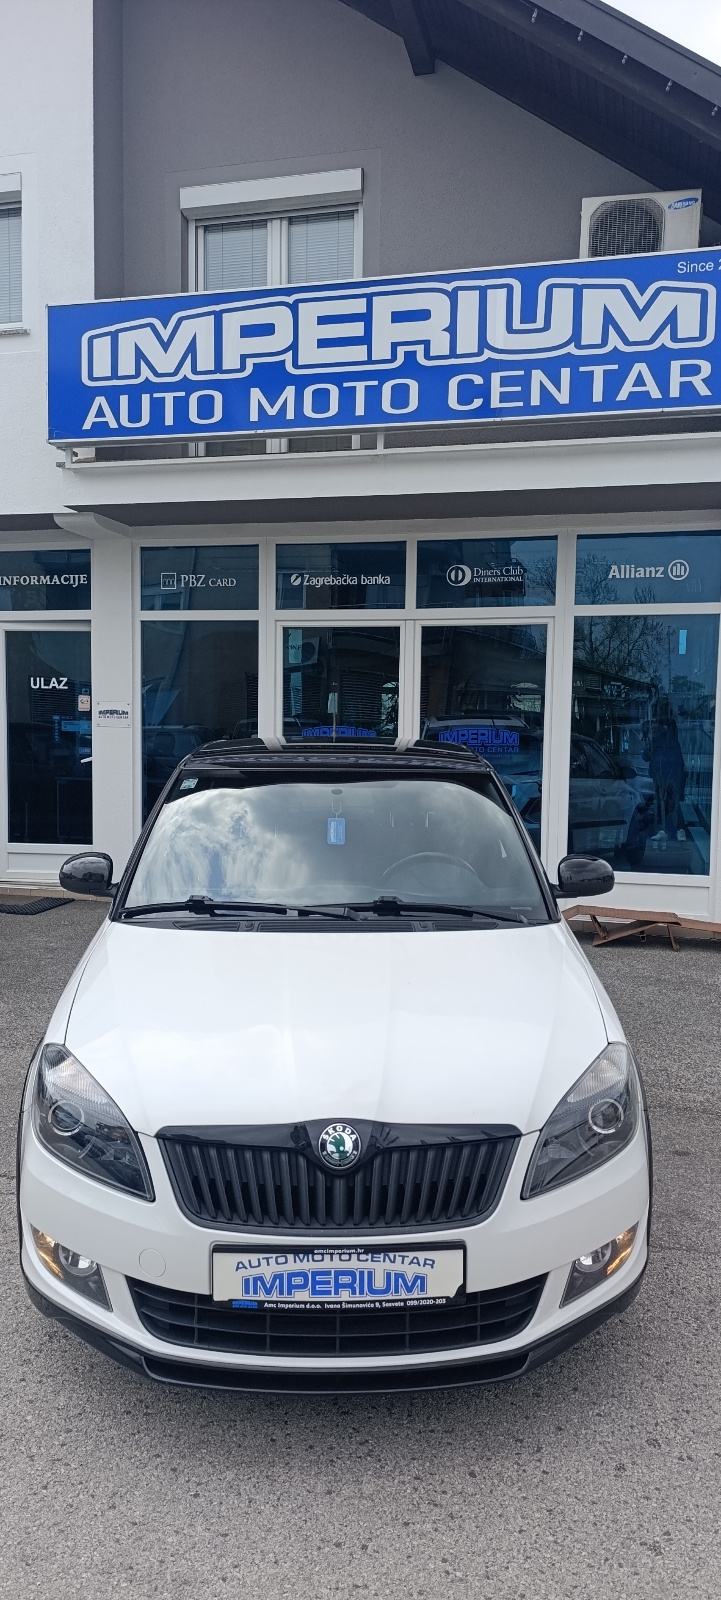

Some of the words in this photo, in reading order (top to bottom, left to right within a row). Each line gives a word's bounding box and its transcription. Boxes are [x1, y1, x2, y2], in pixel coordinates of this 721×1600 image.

[677, 261, 714, 274] Since
[91, 286, 703, 379] IMPERIUM
[82, 389, 223, 430] AUTO
[249, 378, 419, 422] MOTO
[448, 359, 713, 411] CENTAR
[473, 567, 501, 577] Diners
[502, 565, 524, 576] Club
[608, 564, 665, 579] Allianz
[0, 574, 88, 588] INFORMACIJE
[180, 574, 206, 587] PBZ
[208, 578, 237, 587] CARD
[303, 574, 358, 588] Zagrebačka
[360, 574, 391, 585] banka
[30, 677, 68, 689] ULAZ
[439, 728, 519, 745] IMPERIUM
[235, 1254, 288, 1272] AUTO
[293, 1253, 352, 1264] MOTO
[356, 1253, 436, 1269] CENTAR
[242, 1268, 428, 1298] IMPERIUM
[277, 1302, 305, 1310] Imperium
